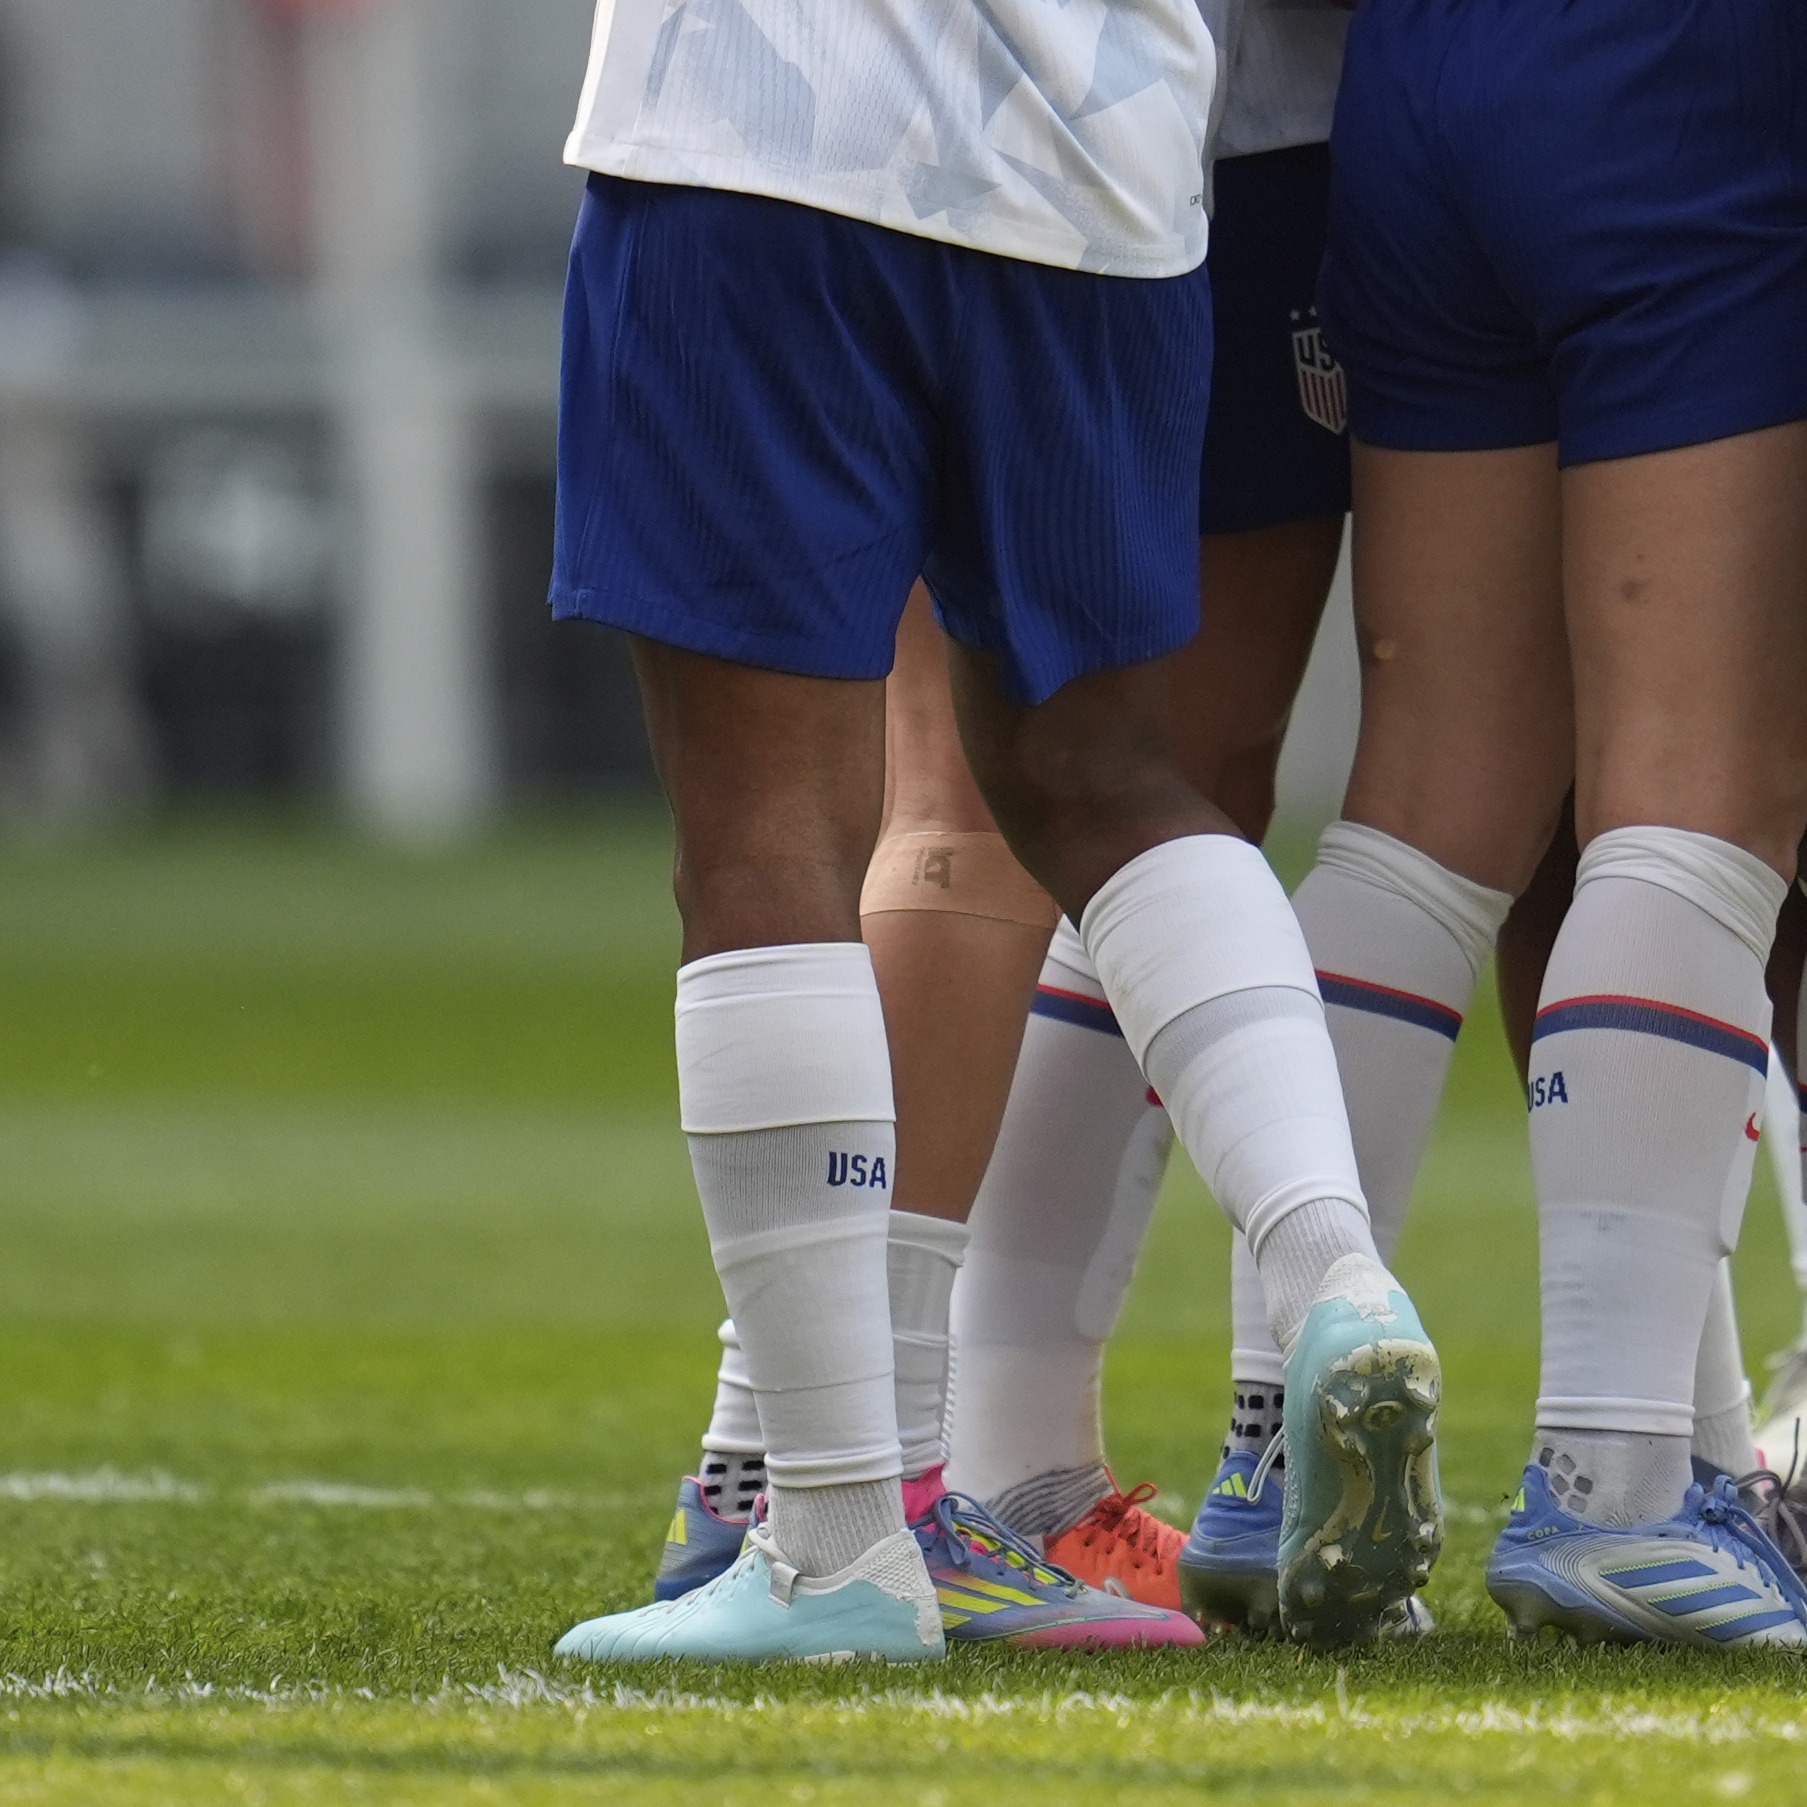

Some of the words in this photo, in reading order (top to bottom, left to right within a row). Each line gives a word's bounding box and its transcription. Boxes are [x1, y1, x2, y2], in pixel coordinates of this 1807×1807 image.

[1527, 1071, 1569, 1113] USA
[827, 1151, 886, 1189] USA
[1527, 1525, 1560, 1541] COPA
